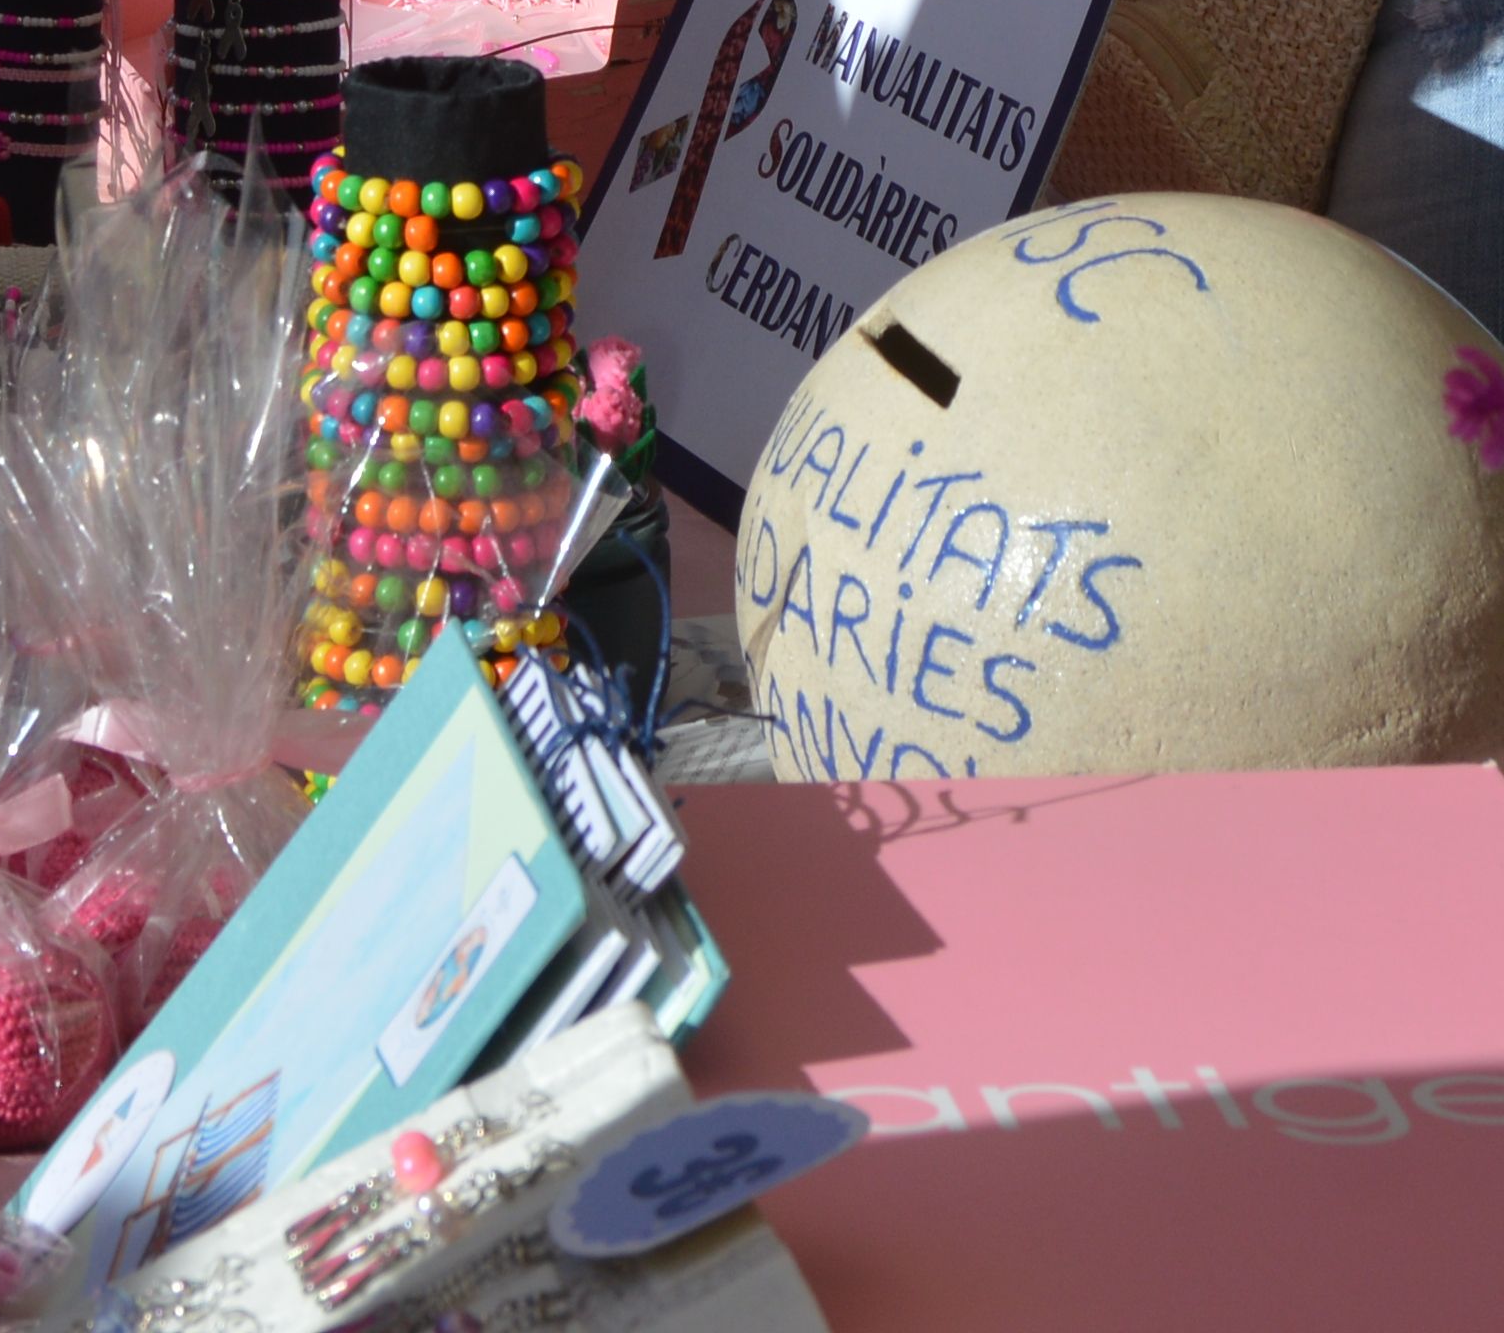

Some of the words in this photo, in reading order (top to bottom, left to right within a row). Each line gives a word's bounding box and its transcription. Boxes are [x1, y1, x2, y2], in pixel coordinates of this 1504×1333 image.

[806, 3, 1036, 172] MANUALITATS
[758, 118, 958, 269] SOLIDÀRIES
[629, 1132, 785, 1221] 3€
